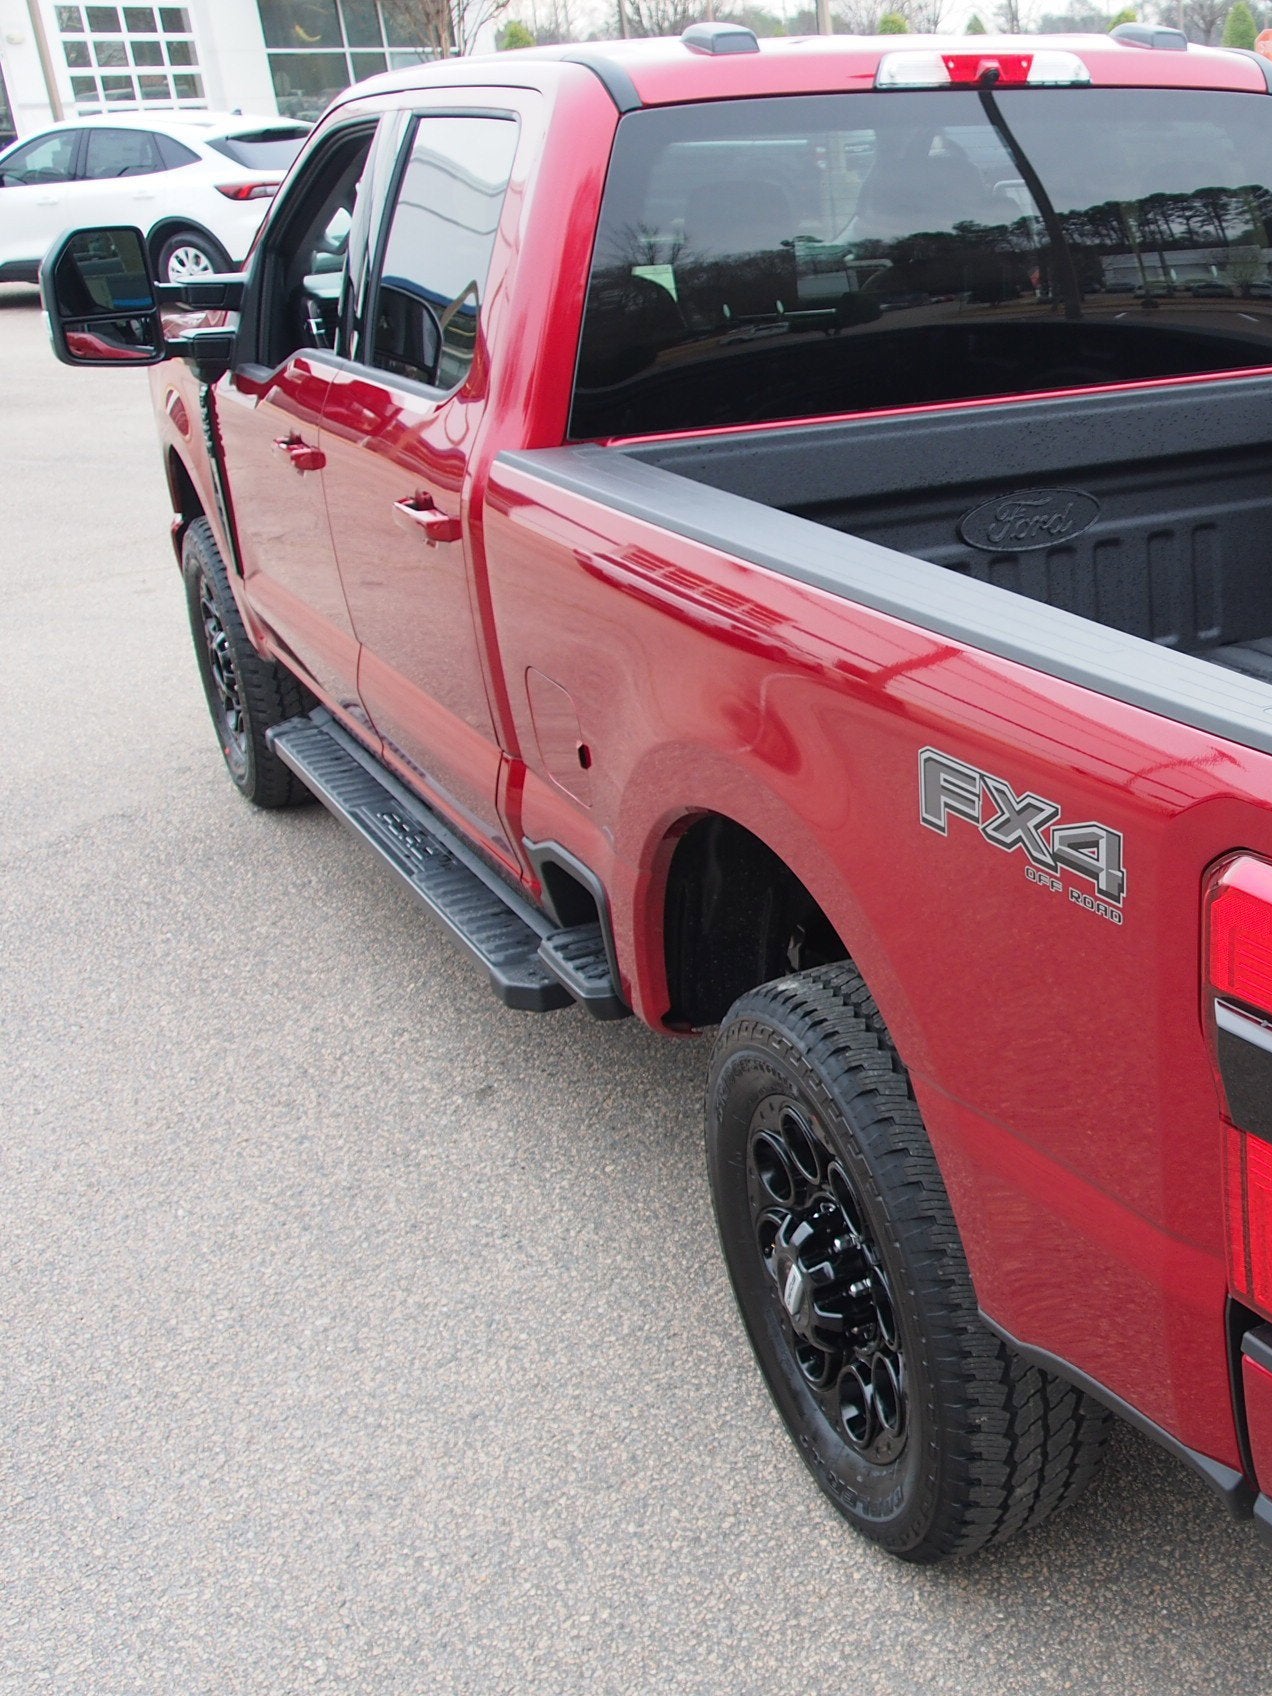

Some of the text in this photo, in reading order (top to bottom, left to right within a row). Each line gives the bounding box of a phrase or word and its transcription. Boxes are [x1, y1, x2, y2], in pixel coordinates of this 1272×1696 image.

[986, 496, 1075, 543] Ford
[918, 746, 1127, 908] FX4
[1024, 866, 1124, 926] OFF ROAD
